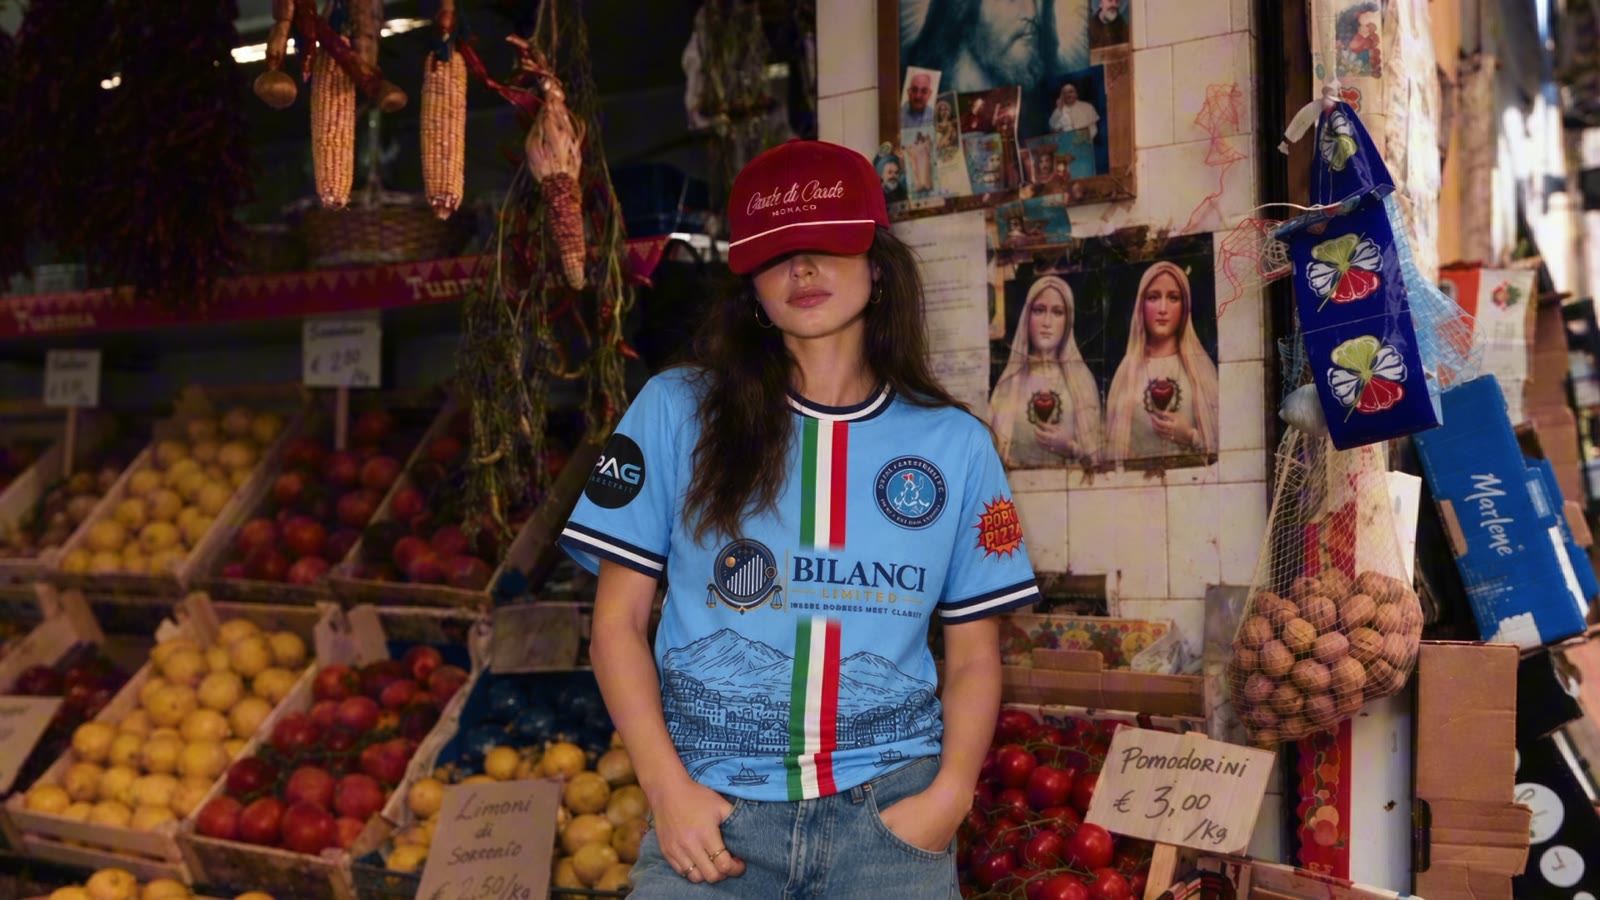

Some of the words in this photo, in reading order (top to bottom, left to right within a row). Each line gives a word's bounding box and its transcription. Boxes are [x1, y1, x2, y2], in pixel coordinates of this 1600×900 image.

[783, 182, 799, 204] di
[772, 204, 817, 216] MONACO
[1463, 473, 1514, 556] Marlene
[792, 556, 927, 593] BILANCI
[822, 589, 898, 604] LIMITED
[455, 792, 535, 821] Limoni
[1113, 789, 1135, 813] €
[1145, 786, 1212, 819] 3,00
[474, 822, 494, 839] di
